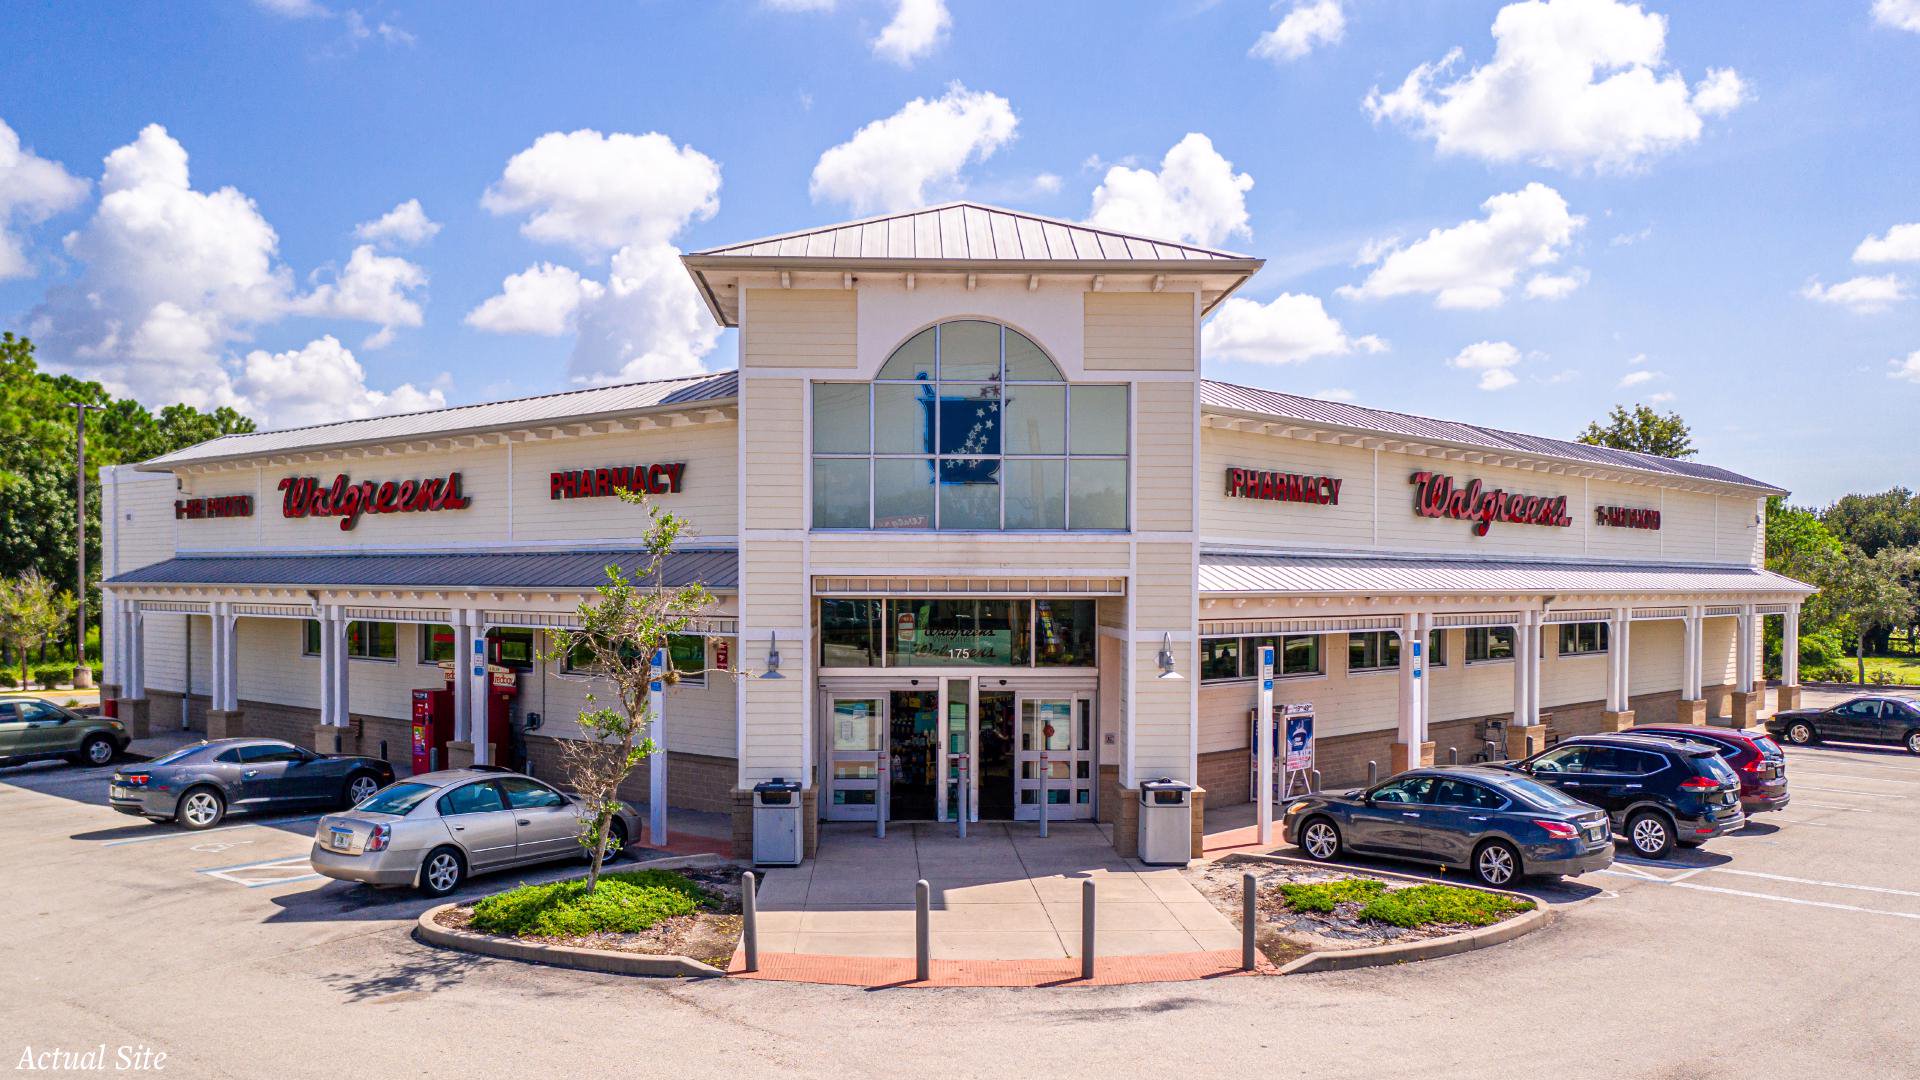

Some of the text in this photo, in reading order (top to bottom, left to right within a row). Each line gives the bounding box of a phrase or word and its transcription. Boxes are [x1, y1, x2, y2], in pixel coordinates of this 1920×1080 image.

[277, 471, 472, 531] Walgreens
[551, 463, 686, 500] PHARMACY
[1225, 467, 1342, 506] PHARMACY
[1409, 472, 1572, 536] Walgreens
[949, 648, 970, 659] 175
